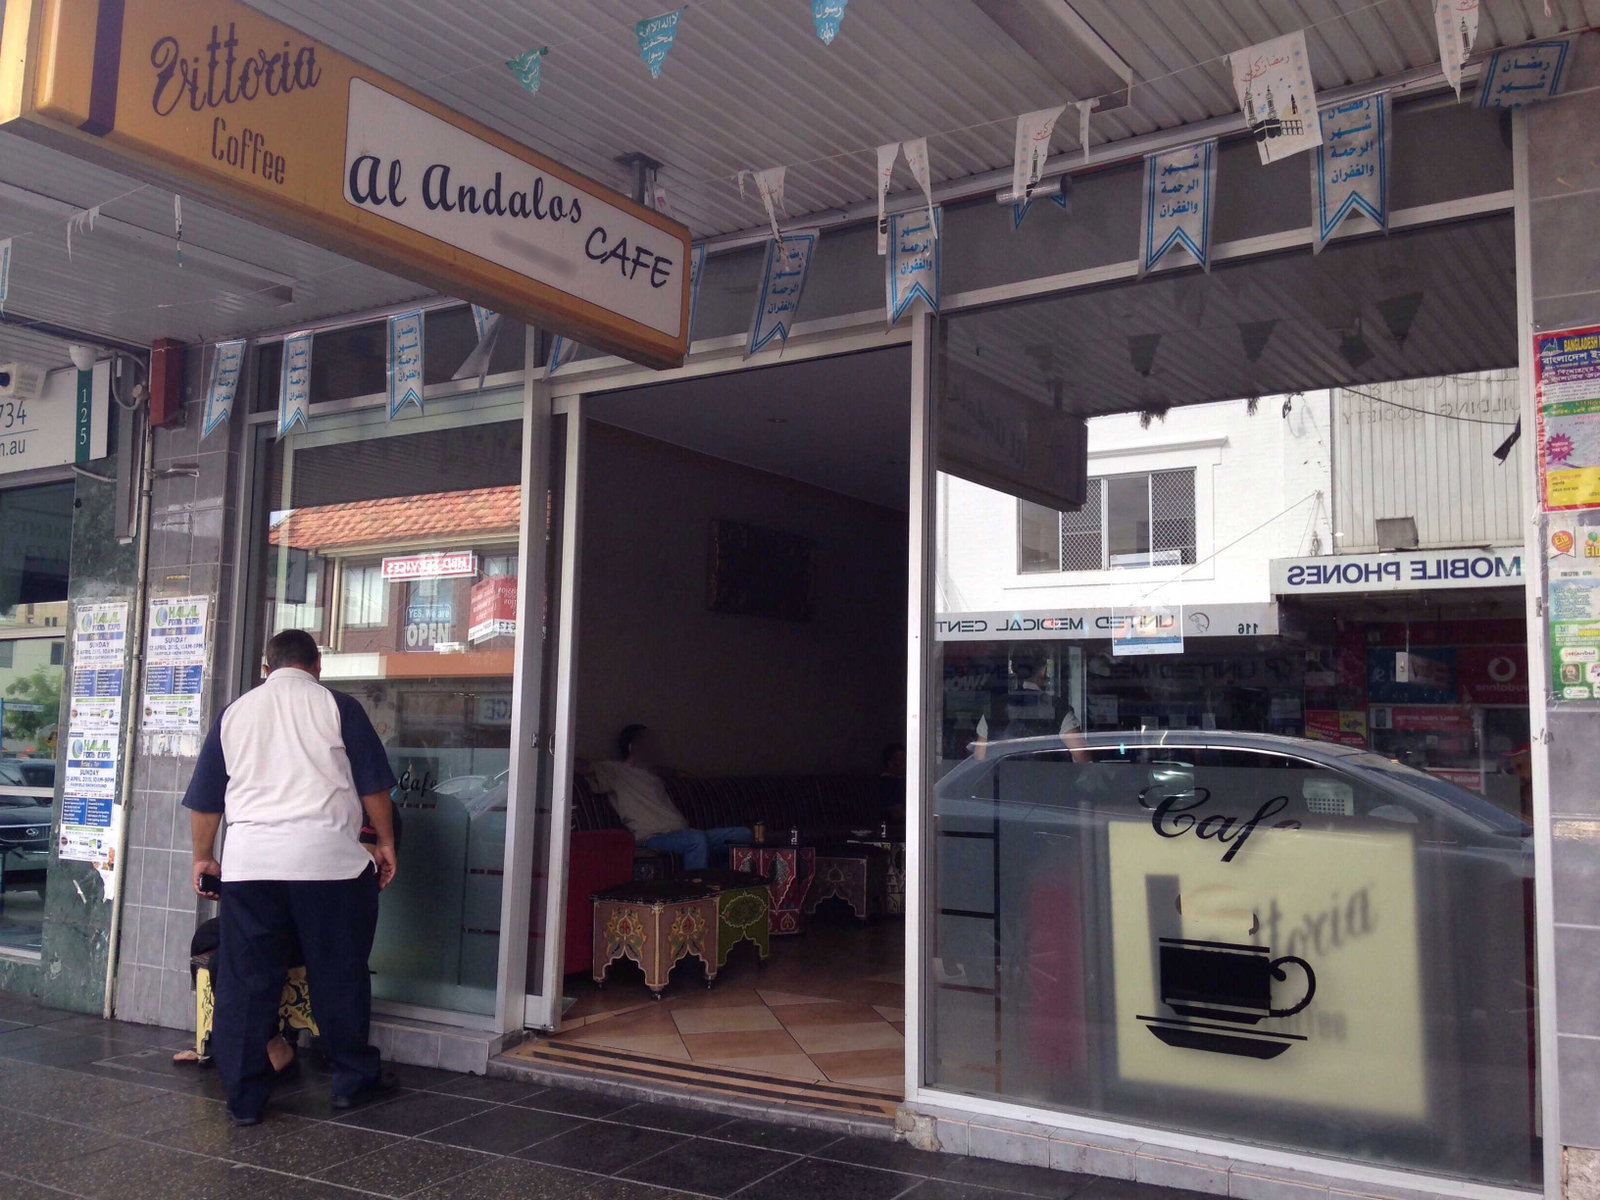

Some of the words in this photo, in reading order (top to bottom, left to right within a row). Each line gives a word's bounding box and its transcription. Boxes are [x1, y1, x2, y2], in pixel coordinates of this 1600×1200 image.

[150, 22, 322, 117] Vittoria
[211, 116, 286, 185] Coffee
[348, 154, 407, 206] Al
[421, 163, 582, 225] Andalos
[585, 227, 673, 289] CAFE
[406, 622, 449, 648] OPEN
